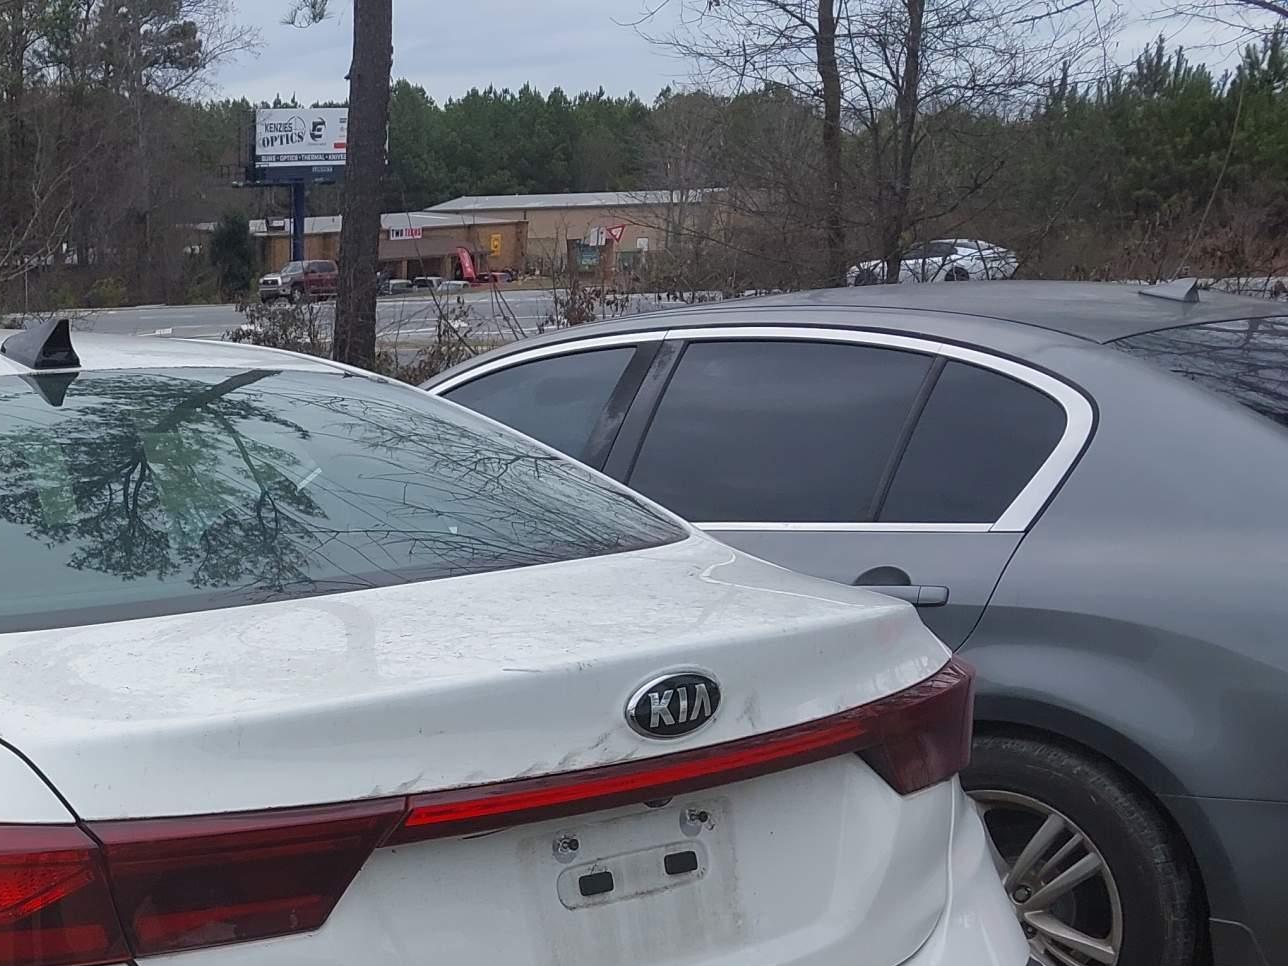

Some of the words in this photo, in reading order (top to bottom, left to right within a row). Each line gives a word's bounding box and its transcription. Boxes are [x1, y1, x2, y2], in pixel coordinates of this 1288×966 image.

[264, 122, 293, 133] KENZIES
[262, 131, 304, 148] OPTICS
[648, 684, 711, 728] KIA
